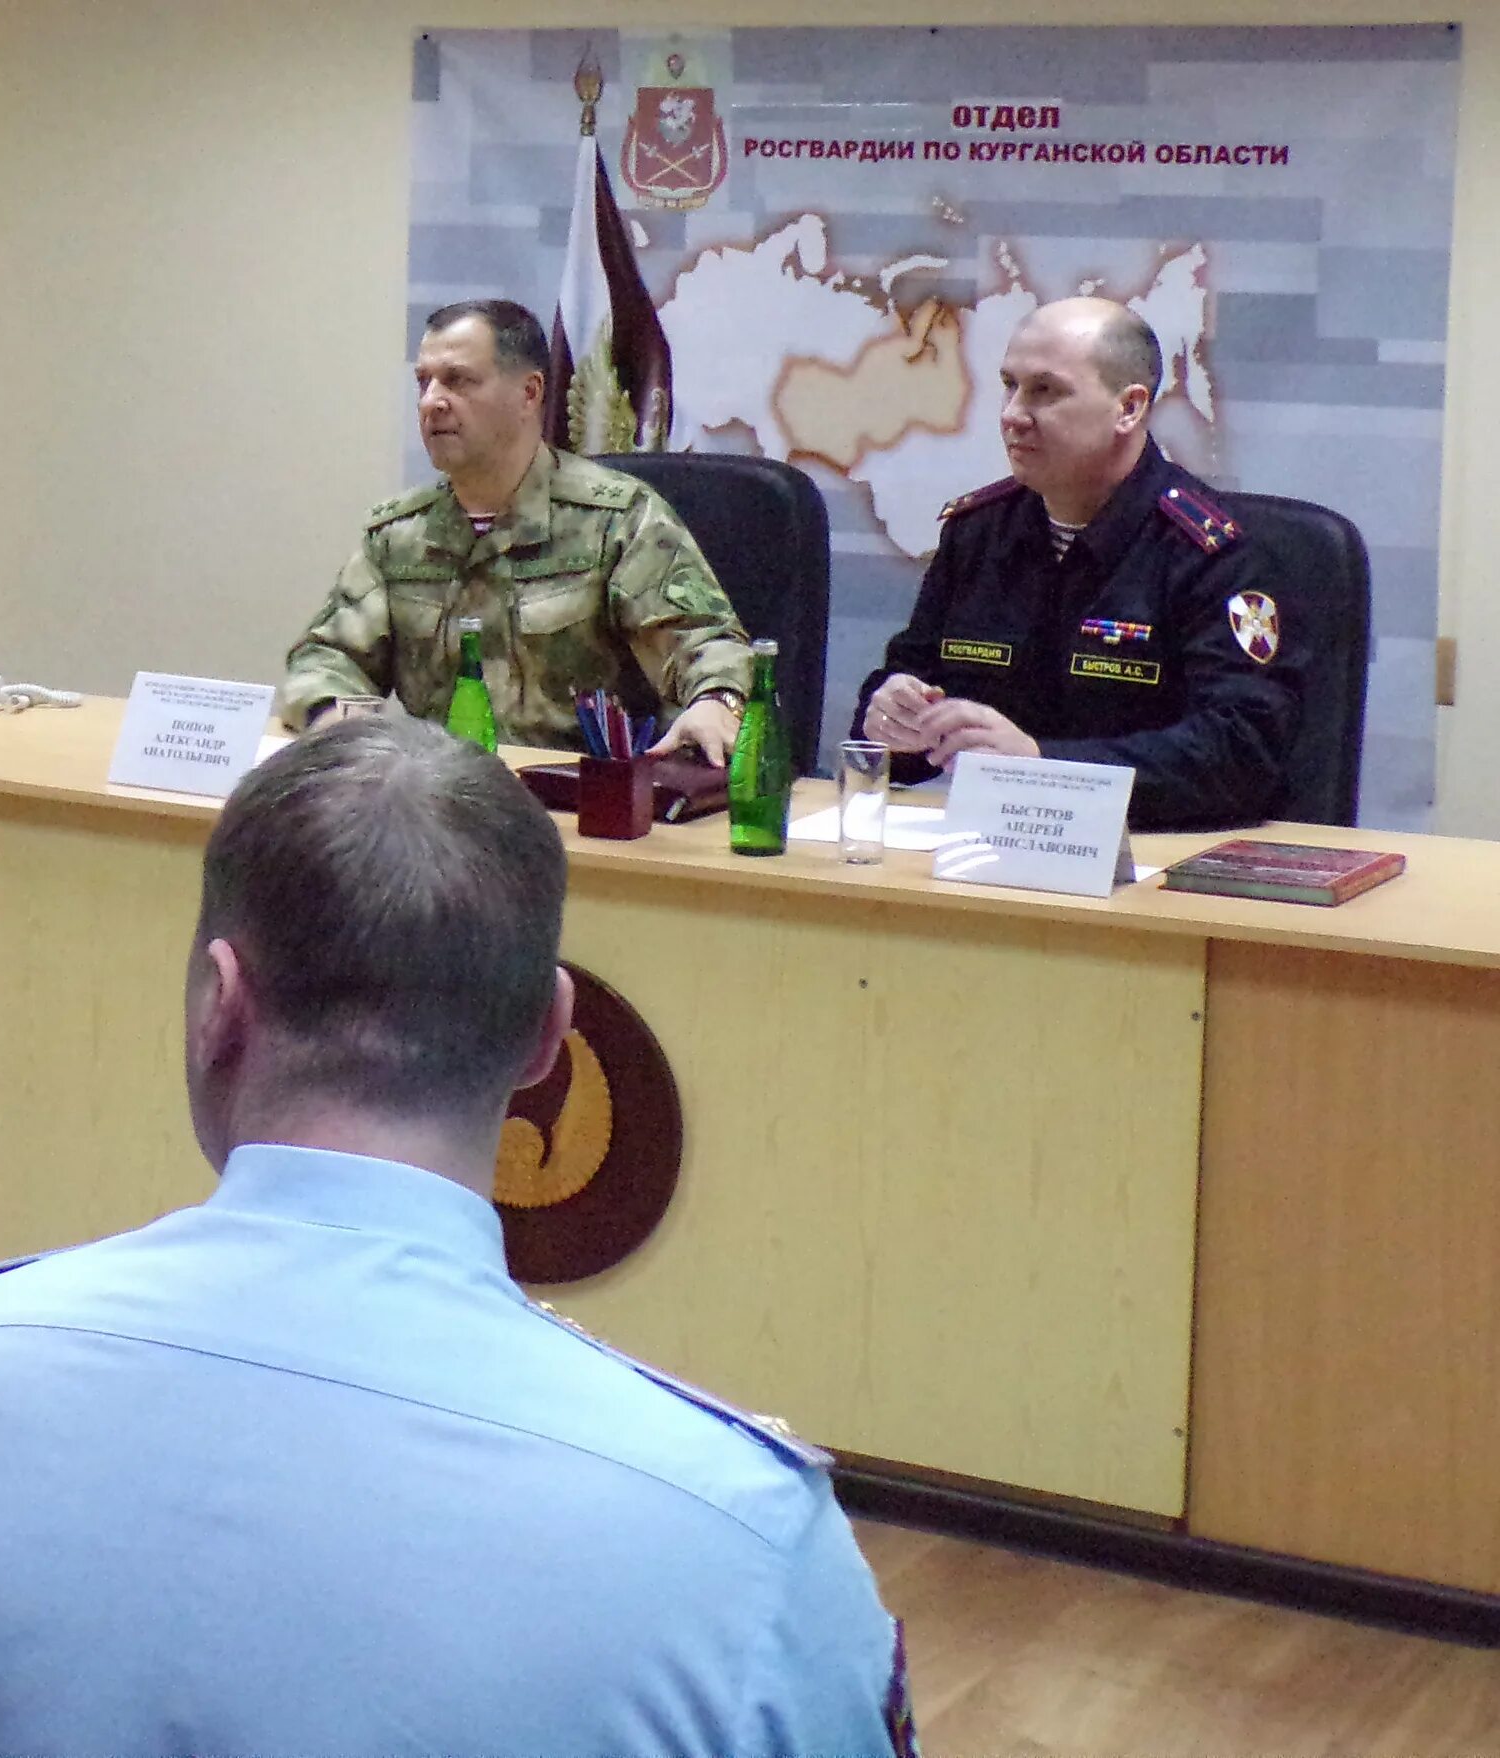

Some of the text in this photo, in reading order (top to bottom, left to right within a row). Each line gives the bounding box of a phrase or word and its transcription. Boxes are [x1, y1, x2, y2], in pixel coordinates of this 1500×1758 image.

[744, 138, 1289, 165] РОСГВАРДИИ ПО КУРГАНСКОЙ ОБЛАСТИ
[171, 719, 215, 734] ПОПОВ
[154, 733, 226, 750] АЛЕКСАНДР
[142, 746, 231, 767] АНАТОЛЬЕВИЧ
[1000, 803, 1074, 821] БЫСТРОВ
[1004, 821, 1065, 837] АНДРЕЙ
[964, 834, 1099, 858] ТАНИСЛАВОВИЧ
